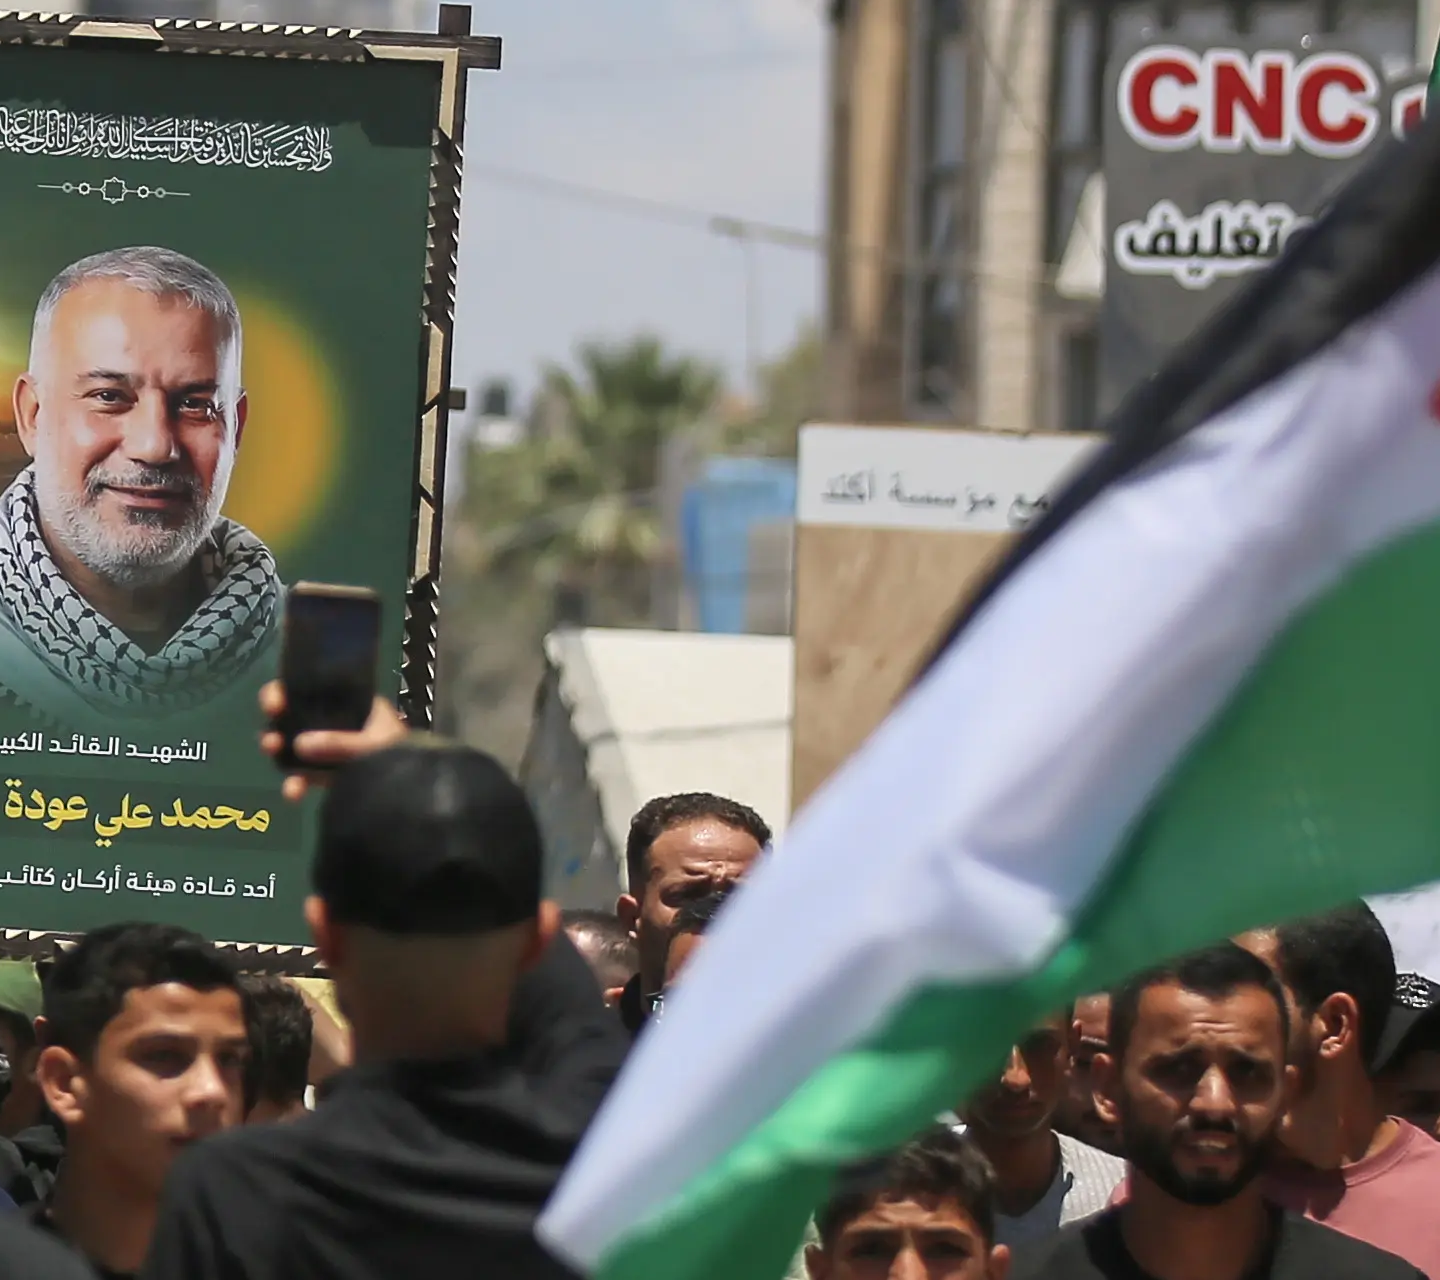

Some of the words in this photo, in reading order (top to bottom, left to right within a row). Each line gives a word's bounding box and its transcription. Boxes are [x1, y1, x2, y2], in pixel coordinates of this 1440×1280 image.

[1123, 52, 1373, 150] CNC
[49, 736, 119, 756] القائد
[126, 742, 207, 763] الشهيد
[4, 777, 88, 830] عودة
[160, 797, 271, 832] محمد
[94, 793, 153, 847] علي
[61, 865, 121, 892] أركان
[125, 870, 176, 893] هيئة
[182, 876, 236, 897] قادة
[242, 873, 276, 899] أحد
